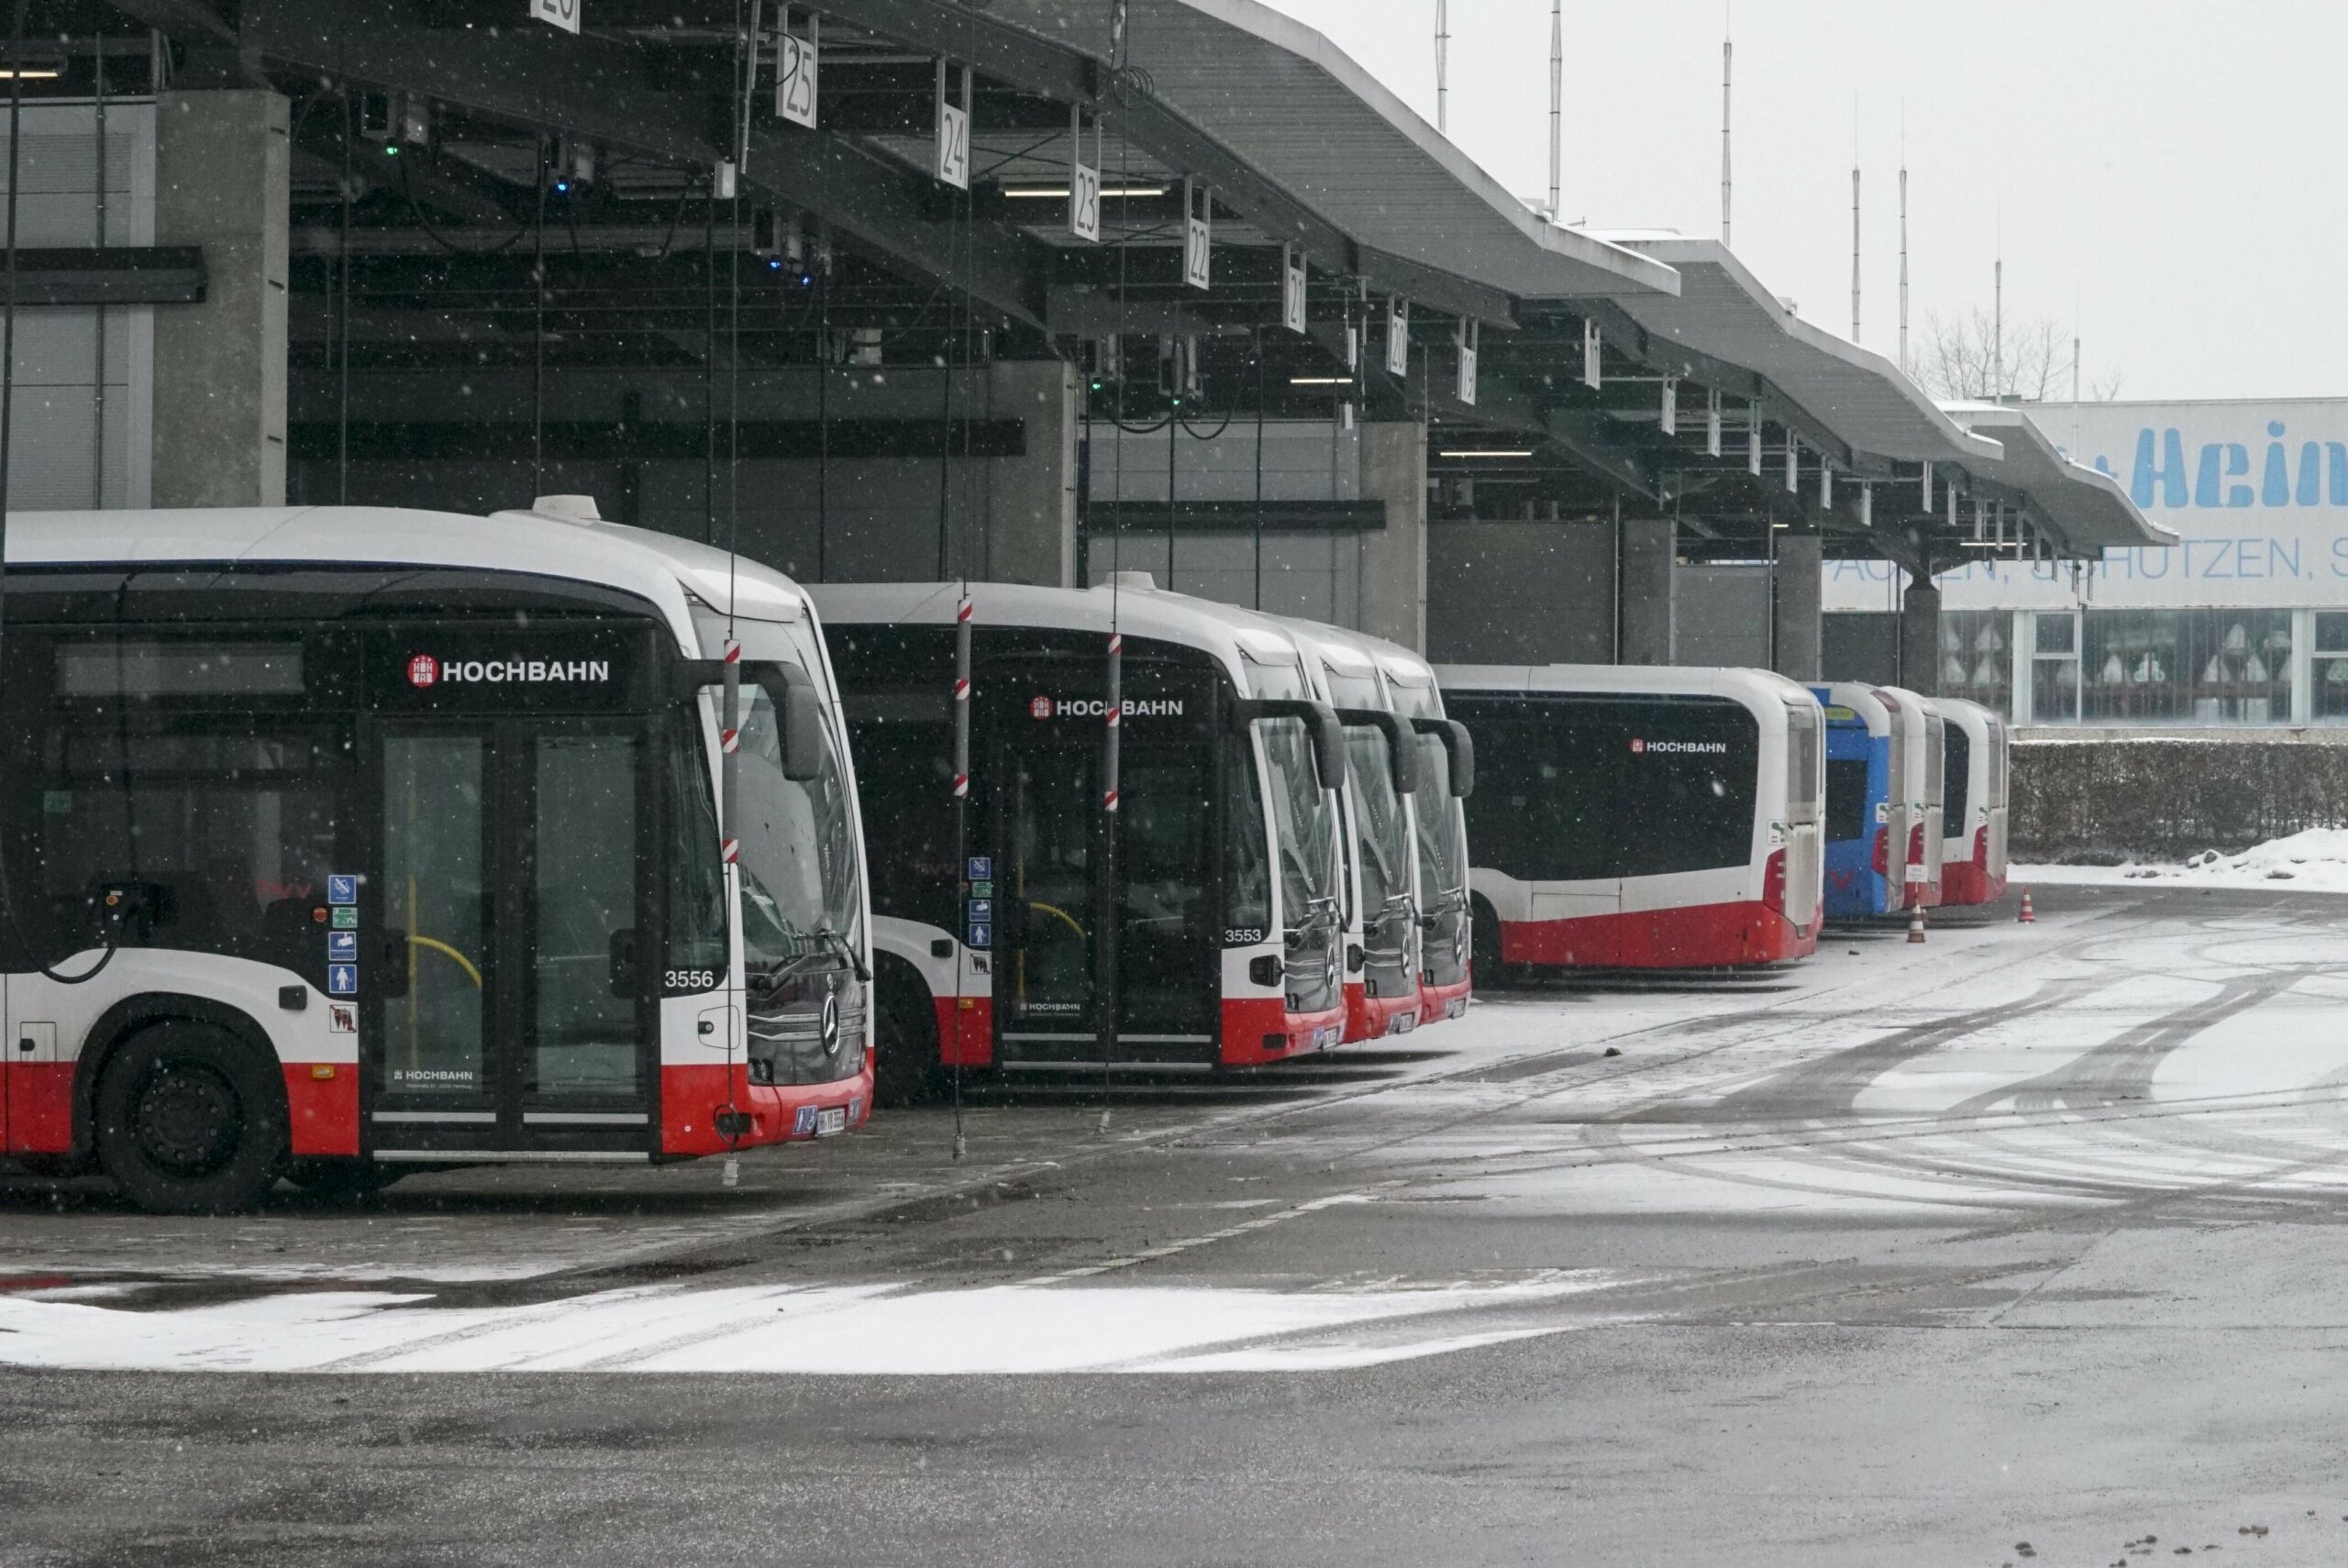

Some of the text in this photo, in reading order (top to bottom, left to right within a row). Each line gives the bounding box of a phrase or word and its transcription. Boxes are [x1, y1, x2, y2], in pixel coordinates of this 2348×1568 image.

[786, 44, 812, 117] 25
[943, 113, 964, 180] 24
[1077, 171, 1096, 233] 23
[1191, 226, 1206, 282] 22
[1290, 274, 1302, 326] 21
[1392, 322, 1404, 370] 20
[1463, 352, 1474, 397] 19
[2031, 537, 2313, 580] HTZEN,
[443, 660, 609, 681] HOCHBAHN
[1057, 700, 1183, 716] HOCBAHN
[1646, 741, 1726, 753] HOCHBAHN
[1224, 928, 1262, 943] 3553
[664, 970, 714, 988] 3556
[1028, 1002, 1080, 1010] HOCHBAHN
[405, 1070, 473, 1080] HOCHBAHN
